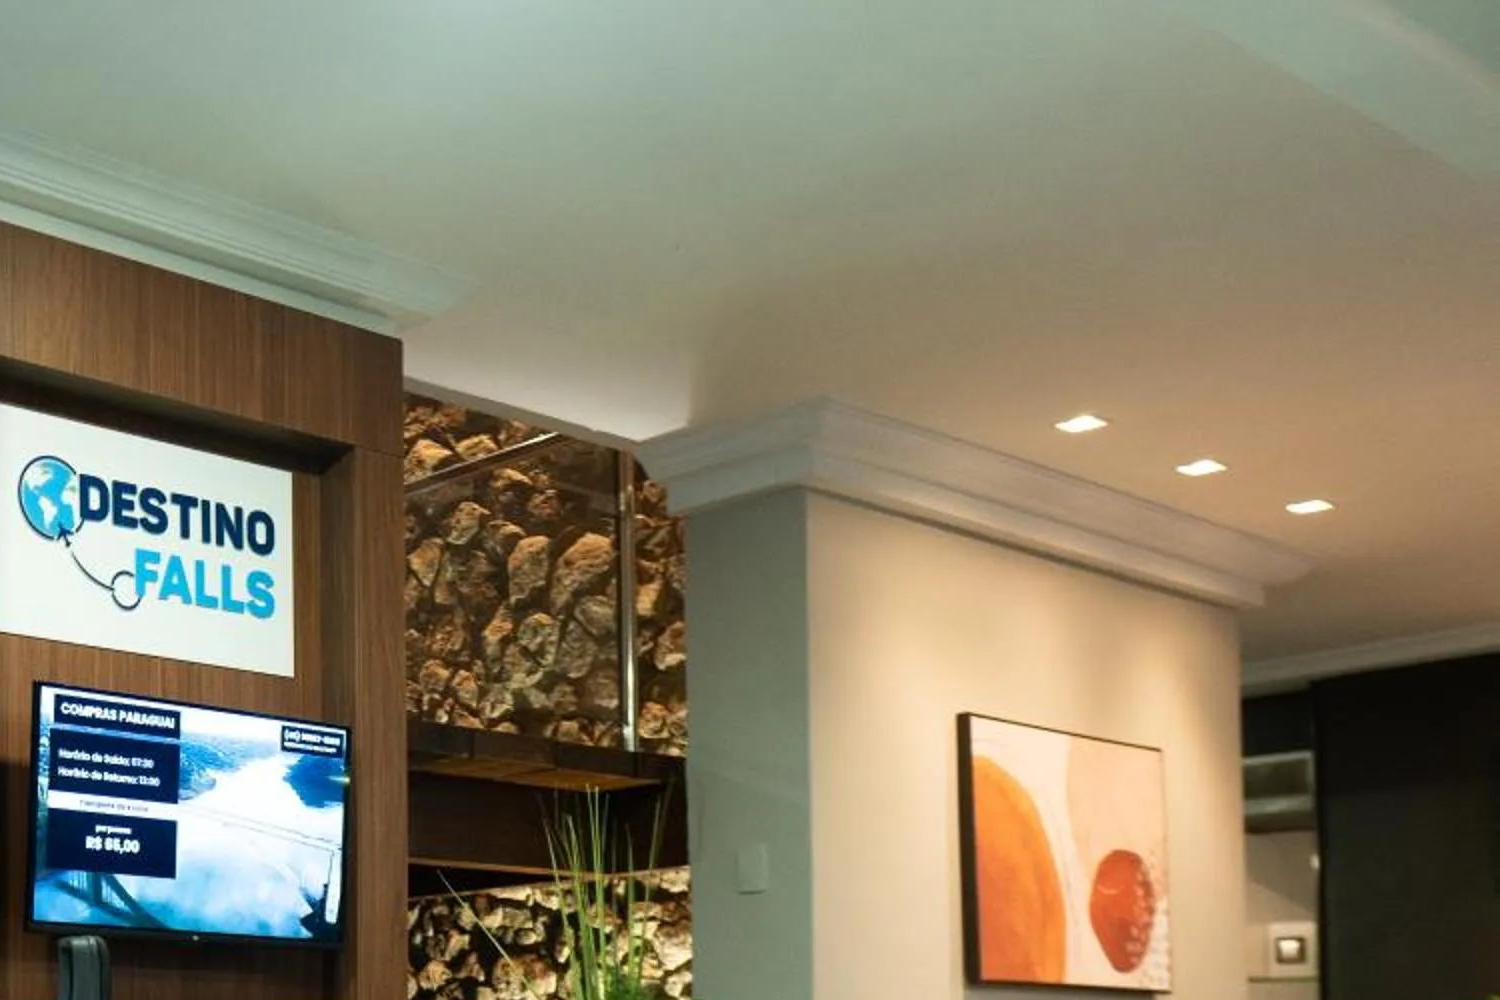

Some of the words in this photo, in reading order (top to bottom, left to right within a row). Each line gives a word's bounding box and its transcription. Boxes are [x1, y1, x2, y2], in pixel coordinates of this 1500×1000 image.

[79, 473, 275, 556] DESTINO
[134, 548, 275, 619] FALLS
[60, 702, 117, 720] COMPRAS
[119, 709, 175, 729] PARAGUAI
[85, 836, 103, 850] R$
